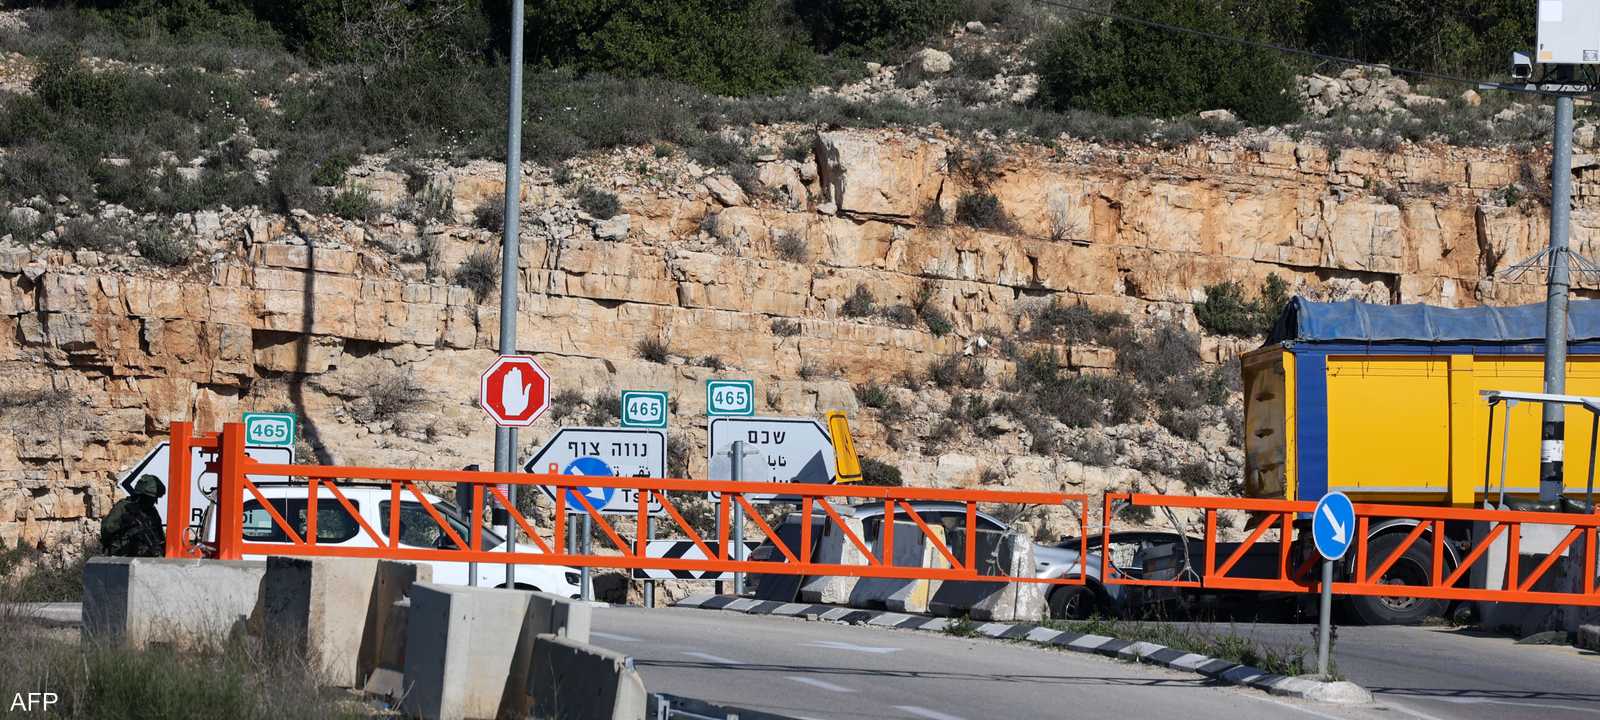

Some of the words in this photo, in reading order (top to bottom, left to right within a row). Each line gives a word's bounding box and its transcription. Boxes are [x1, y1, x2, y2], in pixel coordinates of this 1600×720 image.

[715, 391, 745, 405] 465
[630, 402, 659, 416] 465
[252, 424, 286, 438] 465
[748, 430, 786, 445] שכם
[568, 441, 600, 458] צוף
[611, 442, 647, 457] נווה
